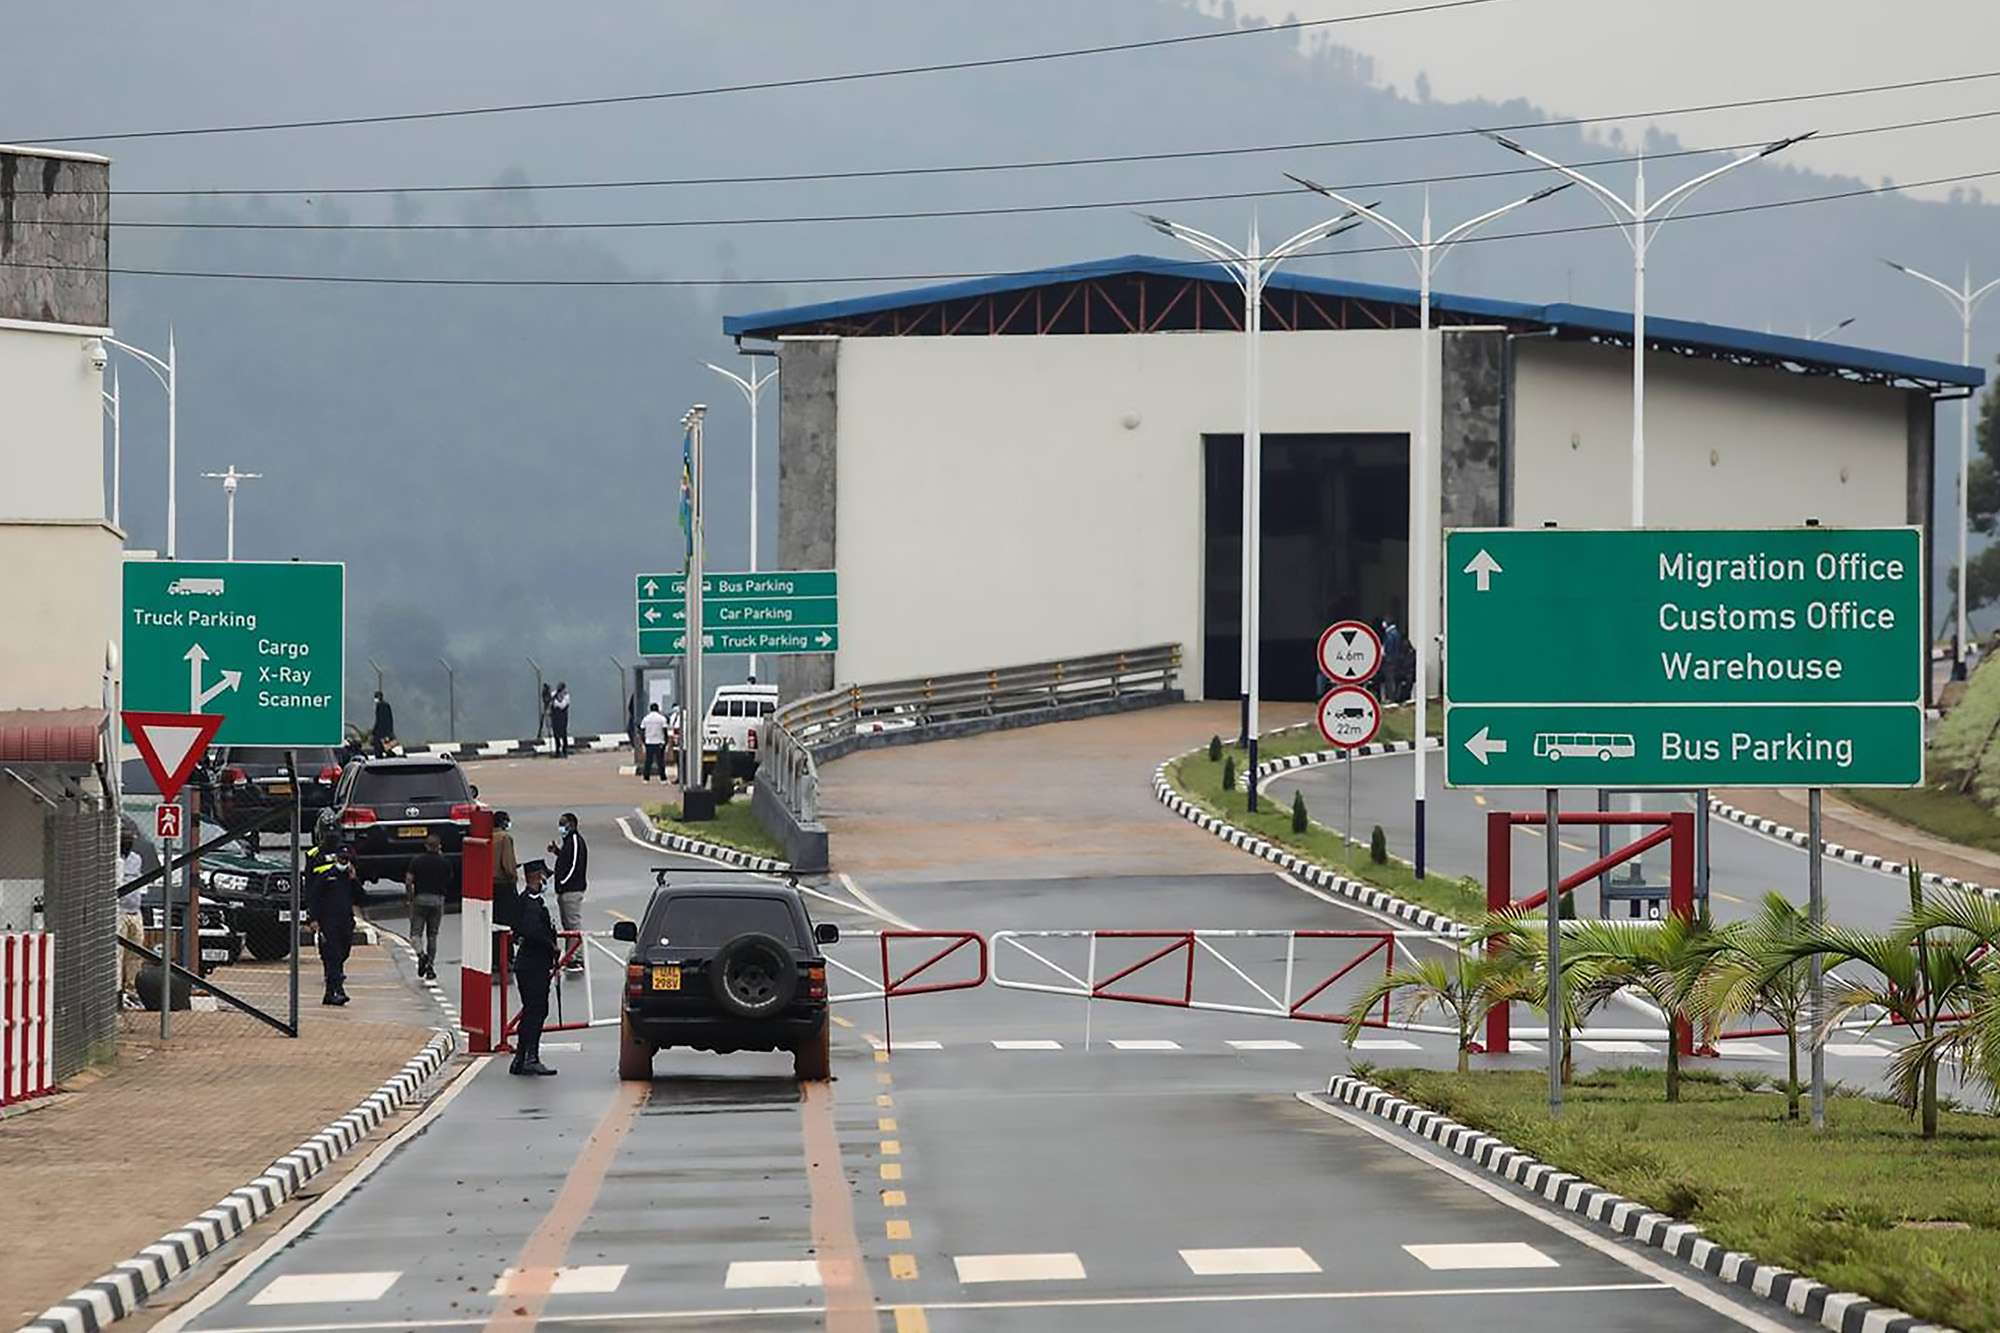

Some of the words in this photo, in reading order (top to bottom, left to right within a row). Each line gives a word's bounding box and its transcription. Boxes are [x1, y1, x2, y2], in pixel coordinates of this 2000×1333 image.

[1659, 552, 1804, 589] Migration
[1816, 552, 1904, 581] Office
[719, 580, 744, 593] Bus
[745, 579, 794, 594] Parking
[133, 608, 183, 626] Truck
[188, 610, 257, 631] Parking
[719, 607, 741, 620] Car
[743, 606, 793, 622] Parking
[1659, 603, 1796, 631] Customs
[1807, 601, 1895, 630] Office
[258, 638, 310, 660] Cargo
[720, 634, 757, 648] Truck
[759, 634, 808, 649] Parking
[1335, 650, 1365, 662] 4.6m
[1661, 652, 1842, 680] Warehouse
[258, 666, 311, 687] X-Ray
[258, 690, 332, 708] Scanner
[1336, 722, 1363, 736] 22m
[1662, 732, 1720, 761] Bus
[1731, 732, 1853, 767] Parking
